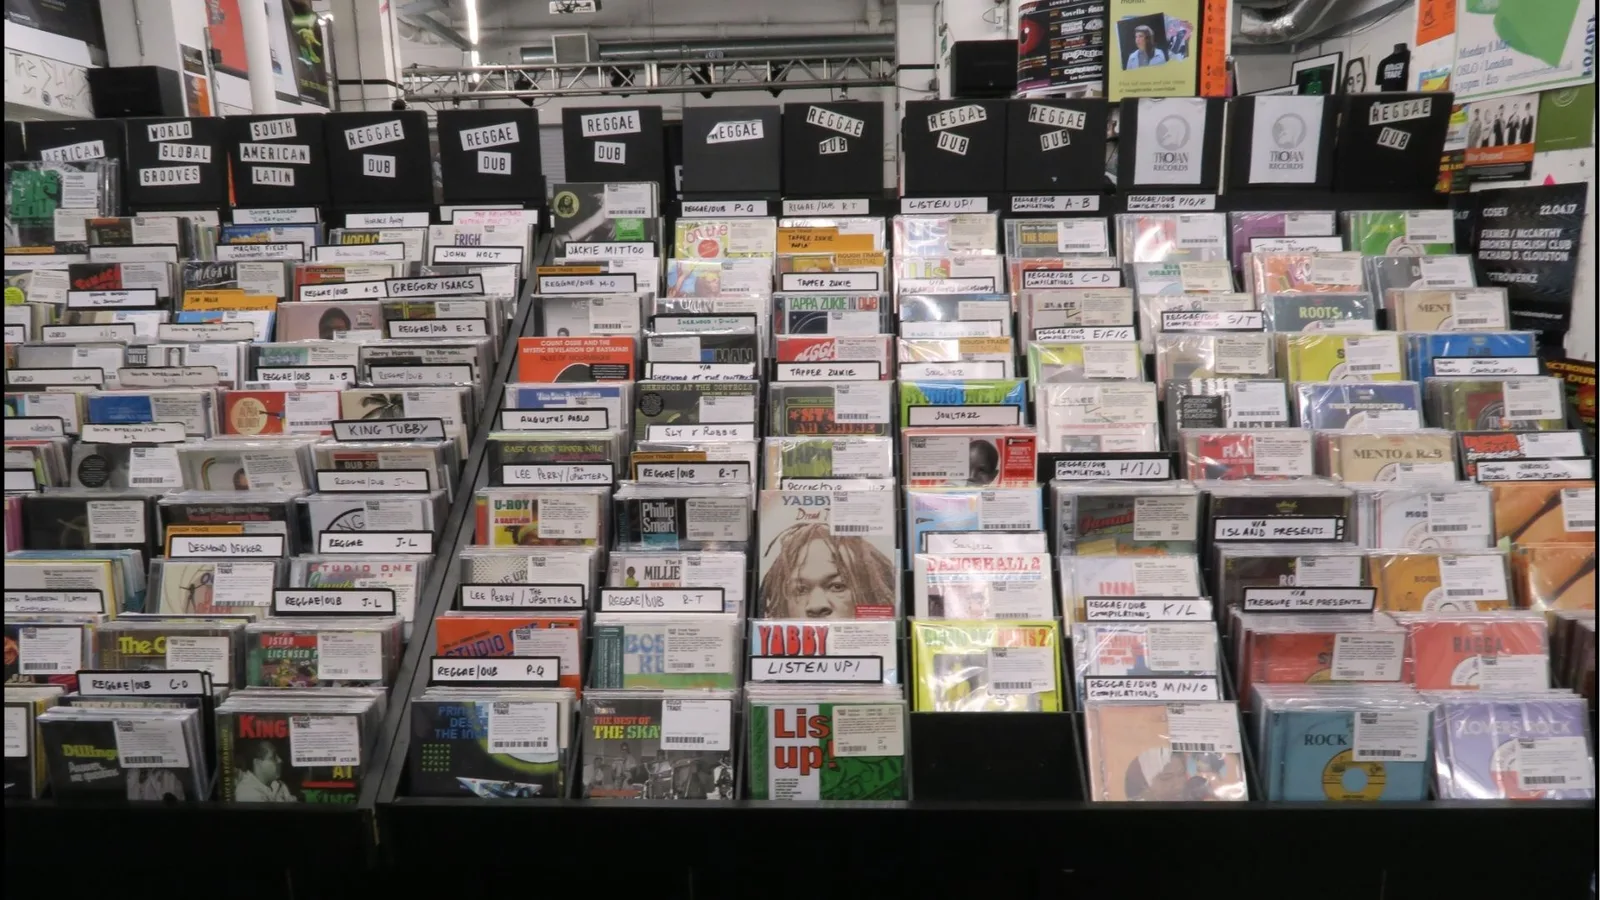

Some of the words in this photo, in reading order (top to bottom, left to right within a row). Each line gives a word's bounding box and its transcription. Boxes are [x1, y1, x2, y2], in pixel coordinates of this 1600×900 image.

[1460, 45, 1486, 59] Monday
[1485, 57, 1513, 70] London
[1030, 106, 1085, 129] REGGAE
[1372, 100, 1430, 122] REGGAE
[587, 115, 634, 133] REGGAE
[809, 108, 863, 137] REGGAE
[931, 106, 985, 131] REGGAE
[150, 124, 190, 139] WORLD
[254, 122, 293, 137] SOUTH
[348, 122, 401, 146] REGGAE
[466, 128, 513, 147] REGGAE
[940, 134, 968, 153] DUB
[1042, 130, 1069, 149] DUB
[1381, 130, 1408, 148] DUB
[162, 145, 209, 160] GLOBAL
[821, 138, 847, 153] DUB
[43, 146, 101, 161] AFRICAN
[243, 146, 307, 161] AMERICAN
[598, 145, 621, 161] DUB
[1153, 152, 1188, 163] TROJAN
[1269, 151, 1304, 162] TROJAN
[368, 158, 391, 174] DUB
[483, 156, 506, 171] DUB
[1153, 164, 1188, 172] RECORDS
[143, 168, 198, 183] GROOVES
[255, 169, 292, 183] LATIN
[684, 205, 726, 213] REGGAE/DUB
[734, 203, 754, 213] P-Q
[909, 200, 950, 208] LISTEN
[954, 200, 973, 208] UP!
[1483, 207, 1508, 217] COSEY
[1540, 204, 1577, 215] 22.04.17
[686, 228, 703, 243] on
[705, 225, 728, 238] the
[1481, 229, 1509, 238] FIXMER
[1516, 228, 1562, 238] McCARTHY
[568, 245, 599, 256] JACKIE
[604, 246, 645, 255] MITTOO
[1480, 240, 1510, 249] BROKEN
[1512, 240, 1547, 249] ENGLISH
[1548, 240, 1572, 249] CLUB
[476, 251, 501, 259] HOLT
[1479, 251, 1511, 260] RICHARD
[1512, 251, 1521, 260] D.
[1523, 251, 1568, 261] CLOUSTON
[393, 281, 438, 293] GREGORY
[441, 280, 475, 290] ISAACS
[544, 279, 594, 289] REGGAE/DUB
[797, 279, 824, 287] TAPPER
[789, 298, 818, 309] TAPPA
[821, 298, 847, 309] ZUKIE
[849, 298, 856, 309] IN
[858, 297, 877, 310] DUB
[1300, 307, 1339, 318] ROOTS
[398, 324, 448, 335] REGGAE/DUB
[715, 348, 753, 362] MAN
[262, 371, 311, 382] REGGAE/DUB
[568, 415, 589, 423] PABLO
[349, 424, 381, 436] KING
[387, 423, 428, 435] TUBBY
[665, 428, 682, 436] SLY
[703, 427, 737, 436] ROBBIE
[1353, 449, 1400, 459] MENTO
[515, 469, 531, 479] LEE
[538, 467, 563, 482] PERRY
[643, 467, 695, 480] REGGAE/DUB
[719, 469, 738, 478] R-T
[1120, 462, 1161, 476] H/I/J
[494, 500, 530, 510] U-ROY
[643, 502, 674, 519] Phillip
[643, 517, 675, 533] Smart
[1222, 528, 1265, 537] ISLAND
[189, 543, 227, 553] DESMOND
[231, 543, 262, 553] DEKKER
[329, 539, 363, 548] REGGAE
[396, 537, 417, 547] J-L
[310, 564, 370, 573] STUDIO
[381, 565, 412, 573] ONE
[927, 557, 1027, 571] DANCEHALL
[1031, 557, 1040, 570] 2
[644, 566, 680, 580] MILLIE
[285, 596, 342, 606] REGGAE/DUB
[362, 598, 382, 608] J-L
[470, 590, 485, 600] LEE
[491, 588, 514, 605] PERRY
[608, 594, 664, 608] REGGAE/DUB
[683, 594, 703, 604] R-T
[1162, 603, 1196, 616] K/L
[121, 637, 149, 654] The
[444, 634, 506, 656] STUDIO
[759, 625, 828, 656] YABBY
[1454, 637, 1502, 652] RAGGA
[268, 649, 311, 659] LICENSED
[438, 665, 498, 679] REGGAE/DUB
[527, 665, 544, 678] P-Q
[768, 661, 828, 675] LISTEN
[834, 661, 860, 677] UP!
[93, 679, 151, 692] REGGAE/DUB
[170, 679, 188, 689] C-D
[1091, 681, 1157, 689] REGGAE/DUB
[1163, 682, 1208, 692] M/N/O
[1090, 690, 1158, 698] COMPILATIONS
[240, 715, 288, 738] KING
[775, 709, 830, 739] Lis
[1457, 720, 1519, 735] LOVERS
[435, 729, 457, 739] THE
[593, 726, 624, 739] THE
[1304, 735, 1347, 746] ROCK
[775, 745, 839, 776] up!
